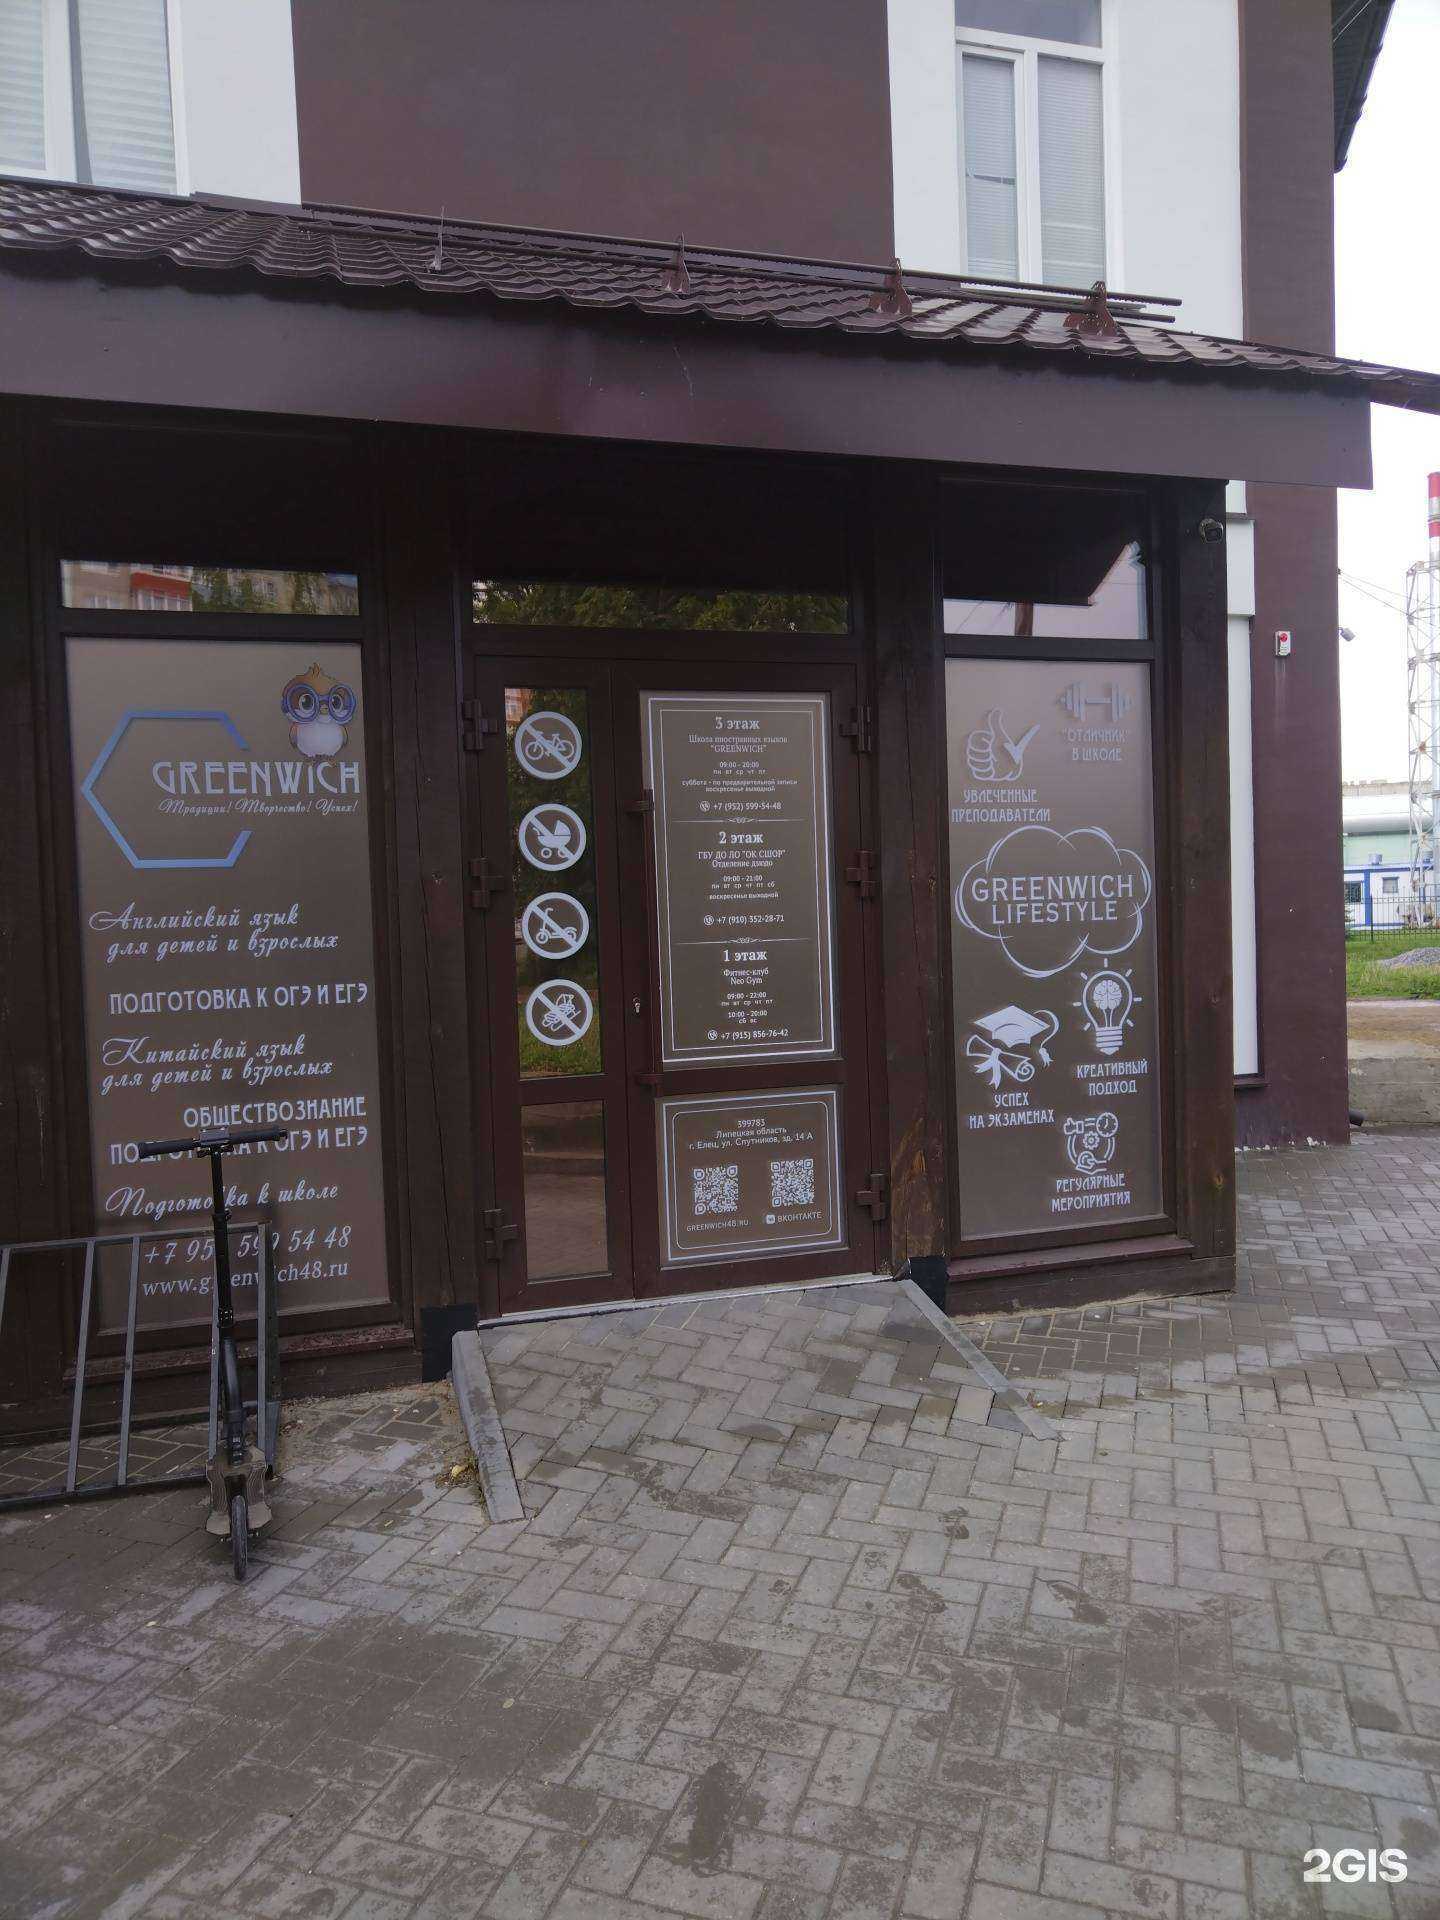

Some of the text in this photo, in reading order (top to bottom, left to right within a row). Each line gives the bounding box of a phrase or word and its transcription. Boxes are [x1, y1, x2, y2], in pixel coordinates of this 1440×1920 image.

[716, 717, 760, 730] 3 этаж
[689, 735, 713, 743] Школа
[715, 736, 762, 744] иностранных
[711, 745, 767, 753] "GREENWICH"
[1072, 748, 1122, 761] В ШКОЛЕ
[152, 761, 361, 796] GREENWICH
[682, 779, 707, 787] суббота
[964, 788, 1038, 803] УВЛЕЧЕННЫЕ
[158, 799, 232, 816] Традиции!
[315, 799, 358, 814] Успех!
[725, 802, 744, 811] (952)
[746, 802, 782, 810] 599-54-48
[952, 808, 1051, 823] ПРЕПОДАВАТЕЛИ
[719, 832, 764, 844] 2 этаж
[698, 852, 713, 860] ГБУ
[716, 851, 728, 860] ДО
[729, 851, 740, 859] ЛО
[712, 860, 750, 868] Отделение
[971, 875, 1133, 901] GREENWICH
[89, 902, 298, 931] Английский язык
[992, 901, 1118, 925] LIFESTYLE
[106, 929, 338, 964] для детей и взрослых
[723, 950, 768, 962] 1 этаж
[724, 968, 769, 977] Фитнес-клуб
[731, 977, 763, 986] Neo Gym
[110, 983, 367, 1014] ПОДГОТОВКА К ОГЭ И ЕГЭ
[733, 1031, 750, 1041] (915)
[103, 1034, 305, 1066] Китайский язык
[1077, 1058, 1148, 1078] КРЕАТИВНЫЙ
[101, 1058, 334, 1095] для детей и взрослых
[1089, 1081, 1137, 1096] ПОДХОД
[994, 1092, 1029, 1107] УСПЕХ
[184, 1096, 366, 1128] ОБЩЕСТВОЗНАНИЕ
[969, 1110, 1055, 1129] НА ЭКЗАМЕНАХ
[738, 1119, 765, 1128] 399783
[317, 1129, 329, 1149] И
[335, 1127, 368, 1147] ЕГЭ
[716, 1127, 787, 1139] Липецкая область
[722, 1140, 732, 1149] ул.
[736, 1137, 780, 1145] Спутников,
[796, 1133, 805, 1141] 14
[1056, 1174, 1125, 1192] РЕГУЛЯРНЫЕ
[106, 1179, 338, 1221] Подготока к школе
[1051, 1191, 1131, 1212] МЕРОПРИЯТИЯ
[778, 1212, 822, 1223] ВКОНТАКТЕ
[187, 1238, 217, 1262] 95
[288, 1228, 315, 1251] 54
[324, 1225, 352, 1248] 48
[144, 1261, 348, 1296] www.gench48.ru
